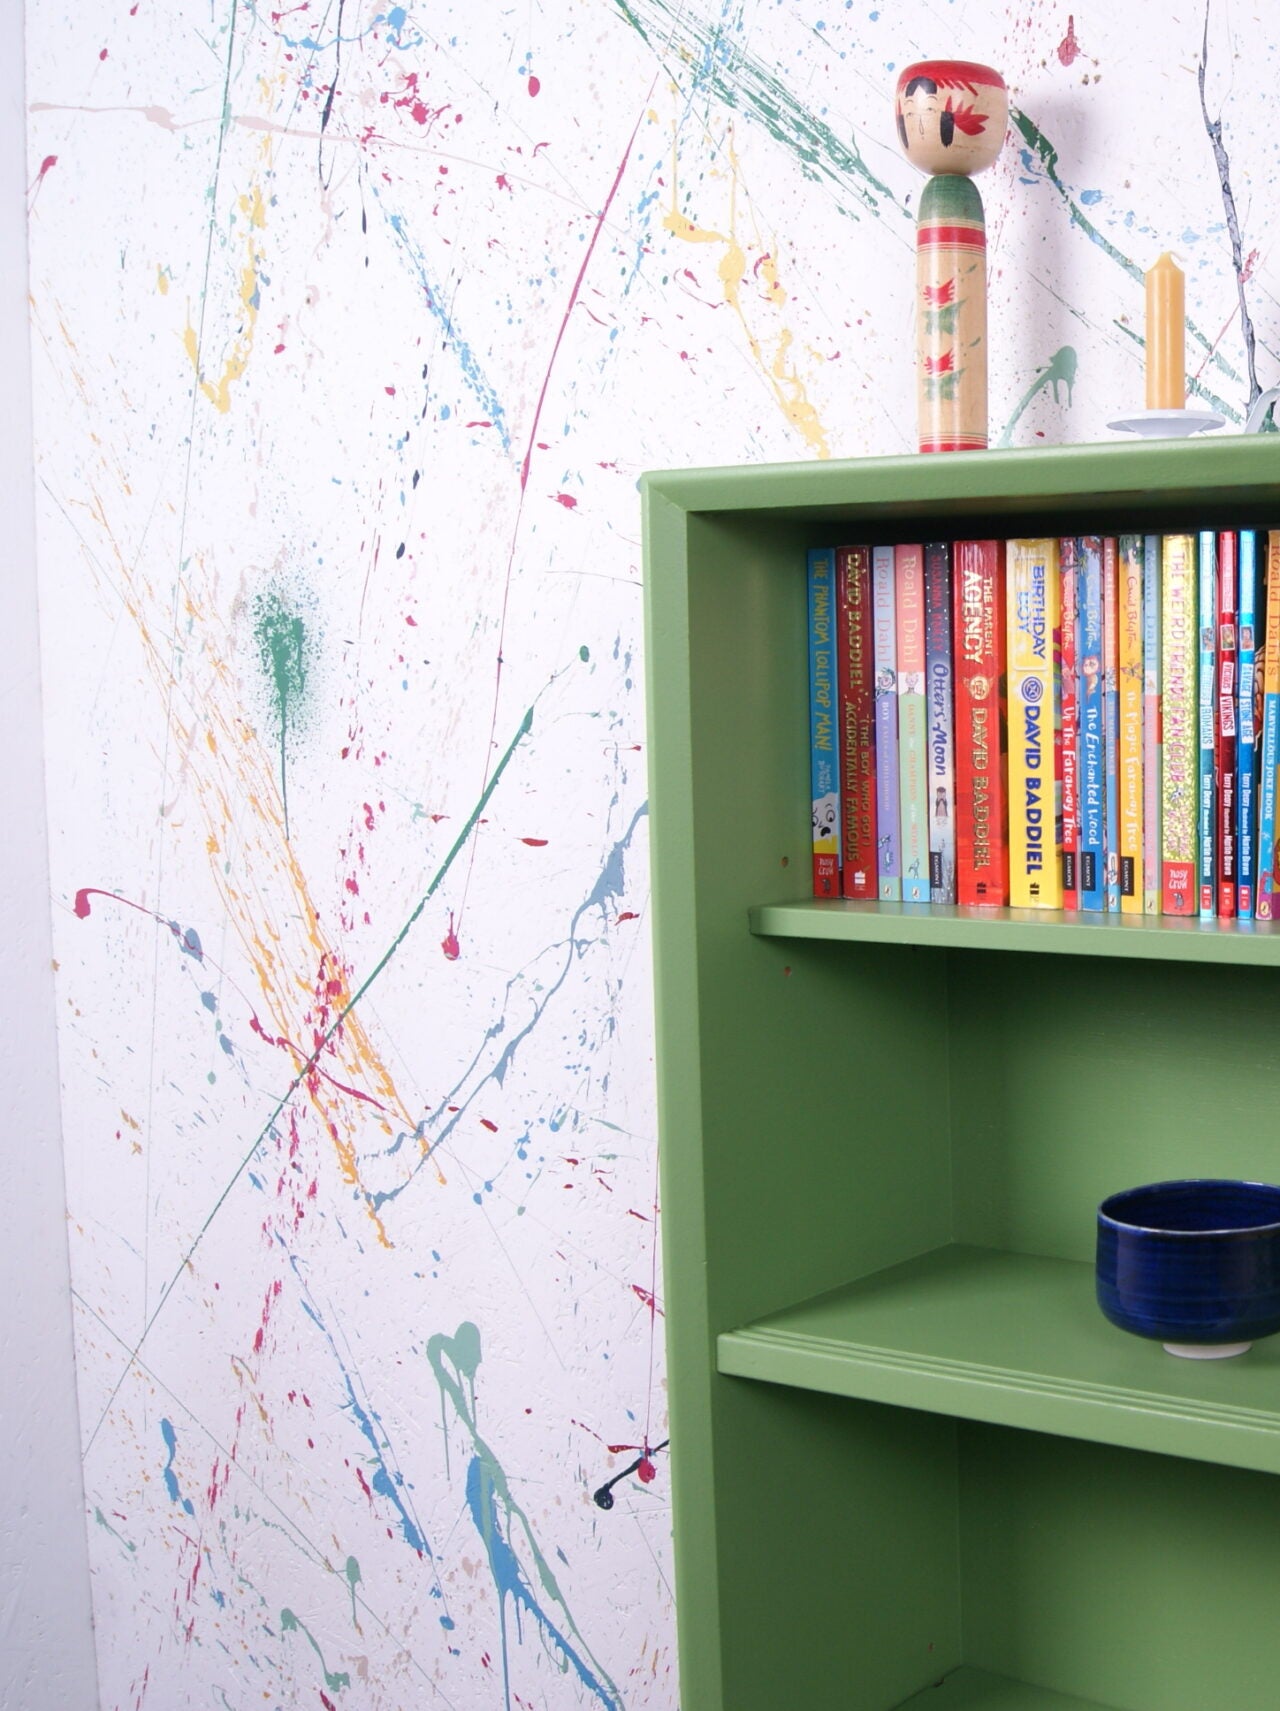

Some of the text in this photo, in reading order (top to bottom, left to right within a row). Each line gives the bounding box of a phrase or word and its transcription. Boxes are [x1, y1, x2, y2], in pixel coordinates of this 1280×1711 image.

[930, 554, 943, 608] SUSANNA
[1171, 552, 1185, 579] THE
[847, 553, 863, 689] DAVID BADDIEL
[876, 557, 891, 662] Roald Dahl
[901, 555, 920, 664] Roald Dahl
[962, 569, 984, 664] AGENCY
[983, 577, 993, 656] THE PARENT
[1017, 591, 1031, 633] BOY
[1032, 565, 1046, 659] BIRTHDAY
[1125, 610, 1138, 650] Blyton
[1267, 544, 1280, 676] Roald Dahl's
[813, 559, 833, 750] THE PHANTOM LOLLIPOP MAN!
[881, 701, 890, 721] BOY
[1222, 663, 1234, 730] VICIOUS VIKINGS
[1241, 666, 1253, 738] SAVAGE STONE AGE
[1125, 711, 1138, 753] Magic
[1170, 707, 1185, 737] FAN
[1201, 708, 1213, 744] ROMANS
[860, 751, 871, 776] BOY
[932, 722, 948, 776] Moon
[1168, 742, 1186, 783] CLUB
[1264, 700, 1277, 820] MARVELLOUS JOKE BOOK
[845, 702, 859, 862] ACCIDENTALLY FAMOUS
[861, 780, 871, 811] WHO
[972, 707, 991, 871] DAVID BADDIEL
[1024, 705, 1043, 875] DAVID BADDIEL
[1062, 706, 1076, 844] Up The Faraway Tree
[1086, 707, 1100, 845] The Enchanted Wood
[1125, 756, 1139, 817] Faraway
[1203, 774, 1212, 789] Terry
[1223, 773, 1233, 788] Terry
[1242, 772, 1252, 788] Terry
[1203, 790, 1212, 808] Deary
[1223, 789, 1233, 807] Deary
[1242, 789, 1252, 807] Deary
[1126, 821, 1139, 851] Tree
[1203, 836, 1212, 856] Martin
[1224, 835, 1233, 855] Martin
[1242, 835, 1252, 855] Martin
[932, 855, 940, 885] EGMONT
[1203, 857, 1212, 876] Brown
[1224, 856, 1233, 875] Brown
[1242, 856, 1251, 875] Brown
